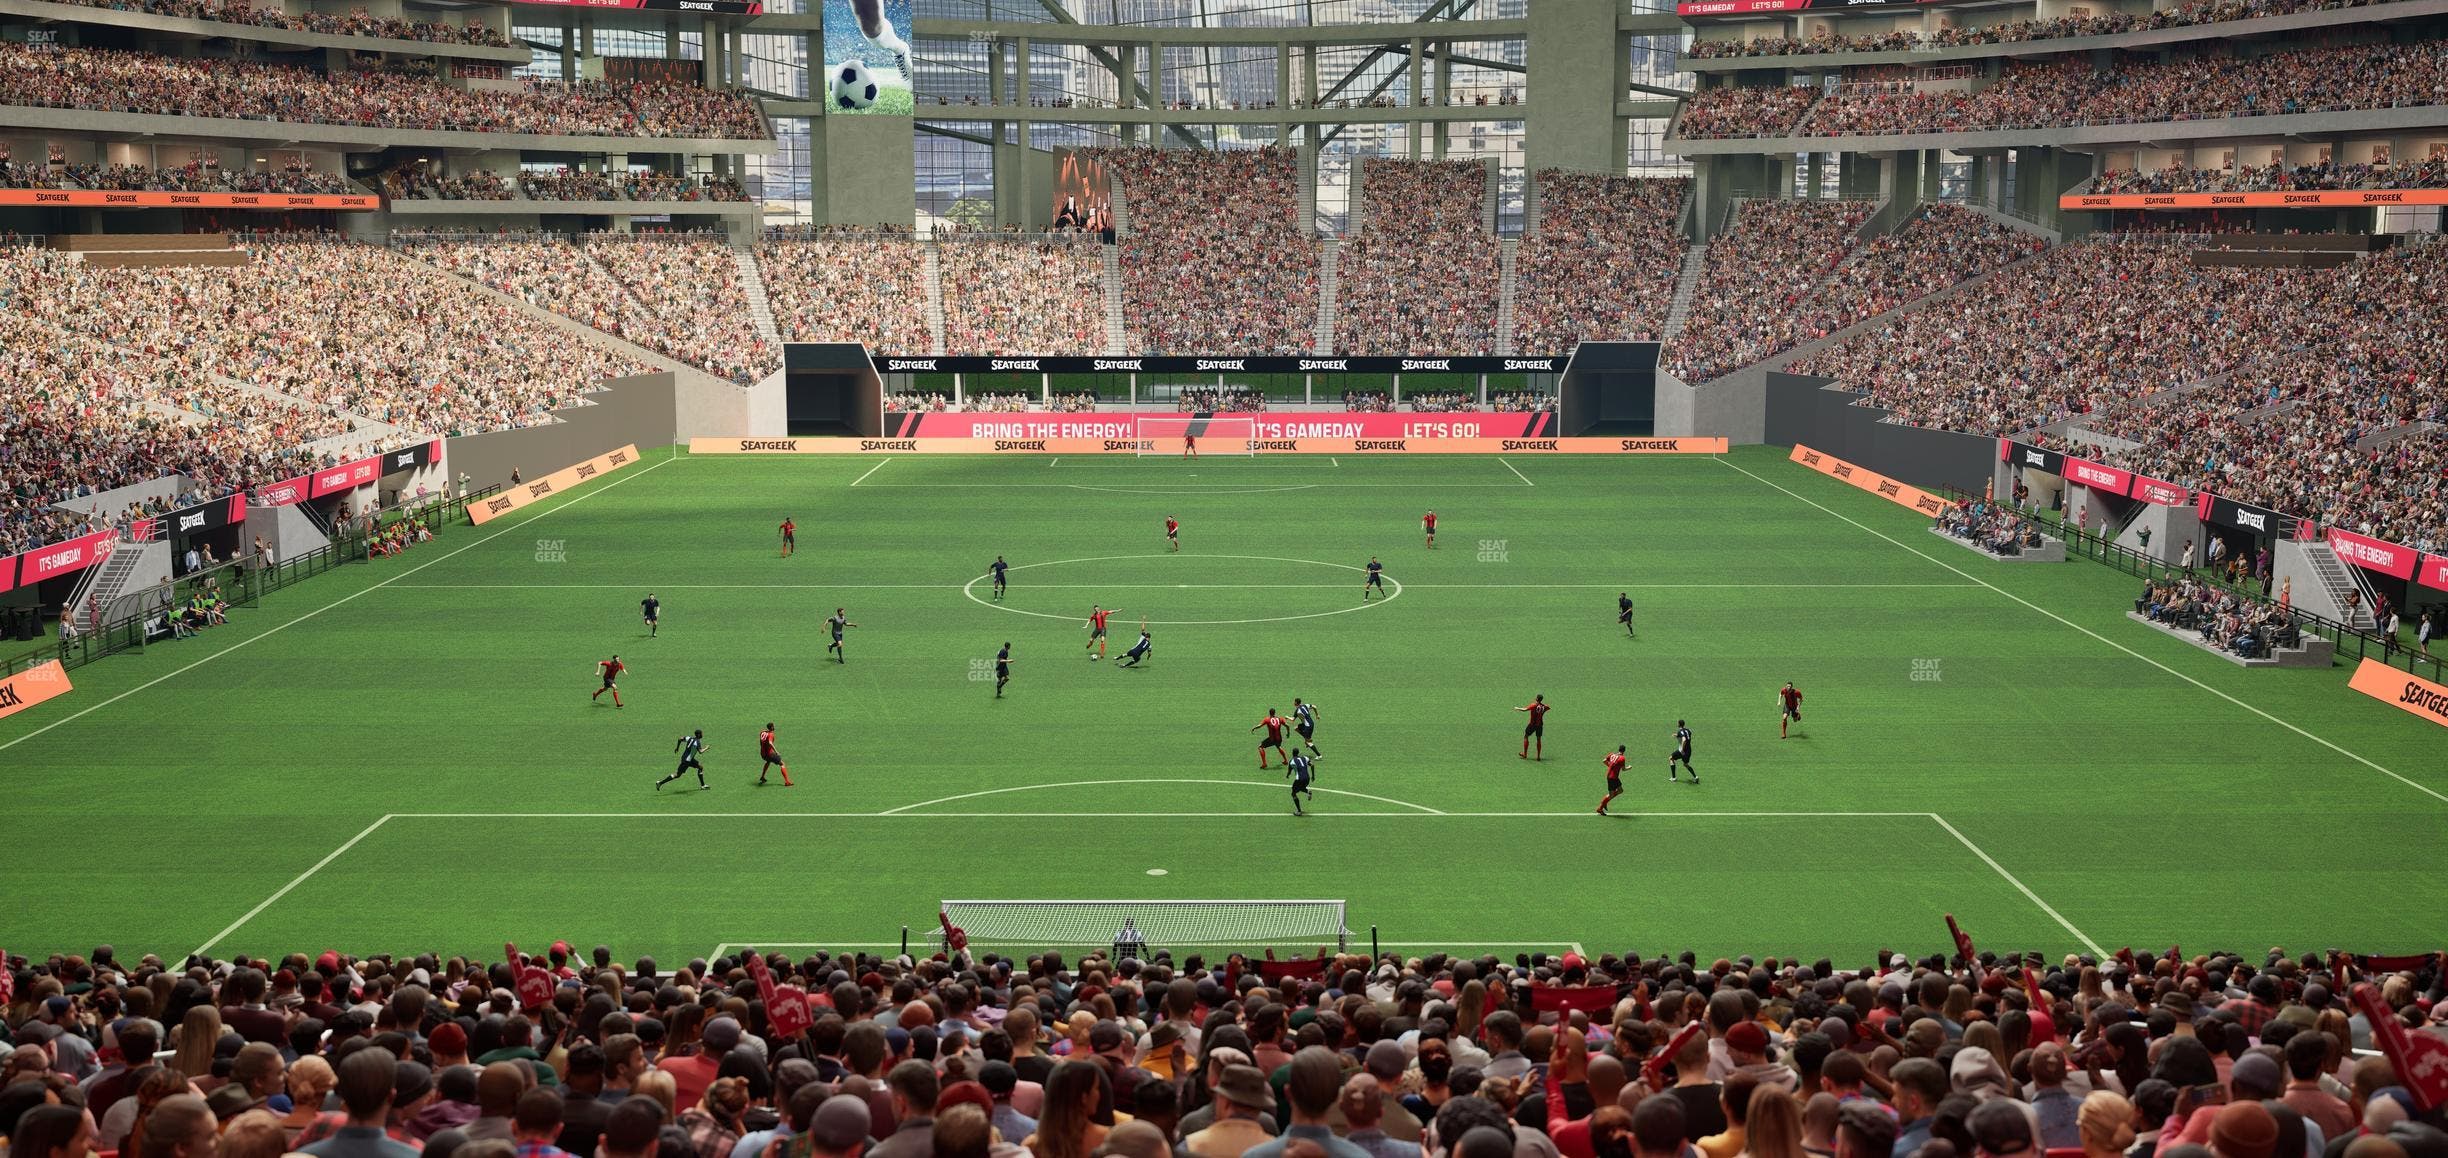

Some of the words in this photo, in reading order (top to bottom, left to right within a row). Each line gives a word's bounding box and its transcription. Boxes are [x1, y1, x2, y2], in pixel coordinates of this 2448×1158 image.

[680, 1, 714, 11] SEATGEEK
[1702, 4, 1735, 12] GAMEDAY
[1752, 1, 1770, 10] LET'S
[36, 193, 69, 202] SEATGEEK
[106, 194, 137, 202] SEATGEEK
[171, 195, 200, 203] SEATGEEK
[2212, 196, 2246, 204] SEATGEEK
[2284, 194, 2320, 203] SEATGEEK
[2363, 193, 2403, 202] SEATGEEK
[889, 360, 937, 371] SEATGEEK
[991, 360, 1039, 371] SEATGEEK
[1094, 360, 1142, 371] SEATGEEK
[1196, 360, 1244, 371] SEATGEEK
[1299, 360, 1347, 371] SEATGEEK
[1401, 360, 1449, 371] SEATGEEK
[1504, 360, 1552, 371] SEATGEEK
[972, 423, 1022, 438] BRING
[1027, 423, 1058, 438] THE
[1062, 423, 1130, 438] ENERGY!
[1286, 423, 1364, 438] GAMEDAY
[1404, 423, 1448, 438] LET'S
[1452, 423, 1480, 438] GO!
[741, 440, 797, 450] SEATGEEK
[861, 440, 917, 450] SEATGEEK
[995, 440, 1045, 450] SEATGEEK
[1104, 440, 1154, 450] SEATGEEK
[1246, 440, 1296, 450] SEATGEEK
[1355, 440, 1406, 450] SEATGEEK
[1502, 440, 1558, 450] SEATGEEK
[1622, 440, 1678, 450] SEATGEEK
[576, 463, 597, 479] SEATGEEK
[529, 480, 552, 498] SEATGEEK
[1878, 480, 1900, 498] SEATGEEK
[488, 494, 513, 514] SEATGEEK
[1916, 495, 1941, 514] SEATGEEK
[179, 510, 206, 532] SEATGEEK
[2237, 508, 2265, 532] SEATGEEK
[39, 556, 51, 572] IT'S
[53, 548, 81, 569] GAMEDAY
[2354, 544, 2366, 560] THE
[2367, 546, 2394, 567] ENERGY!
